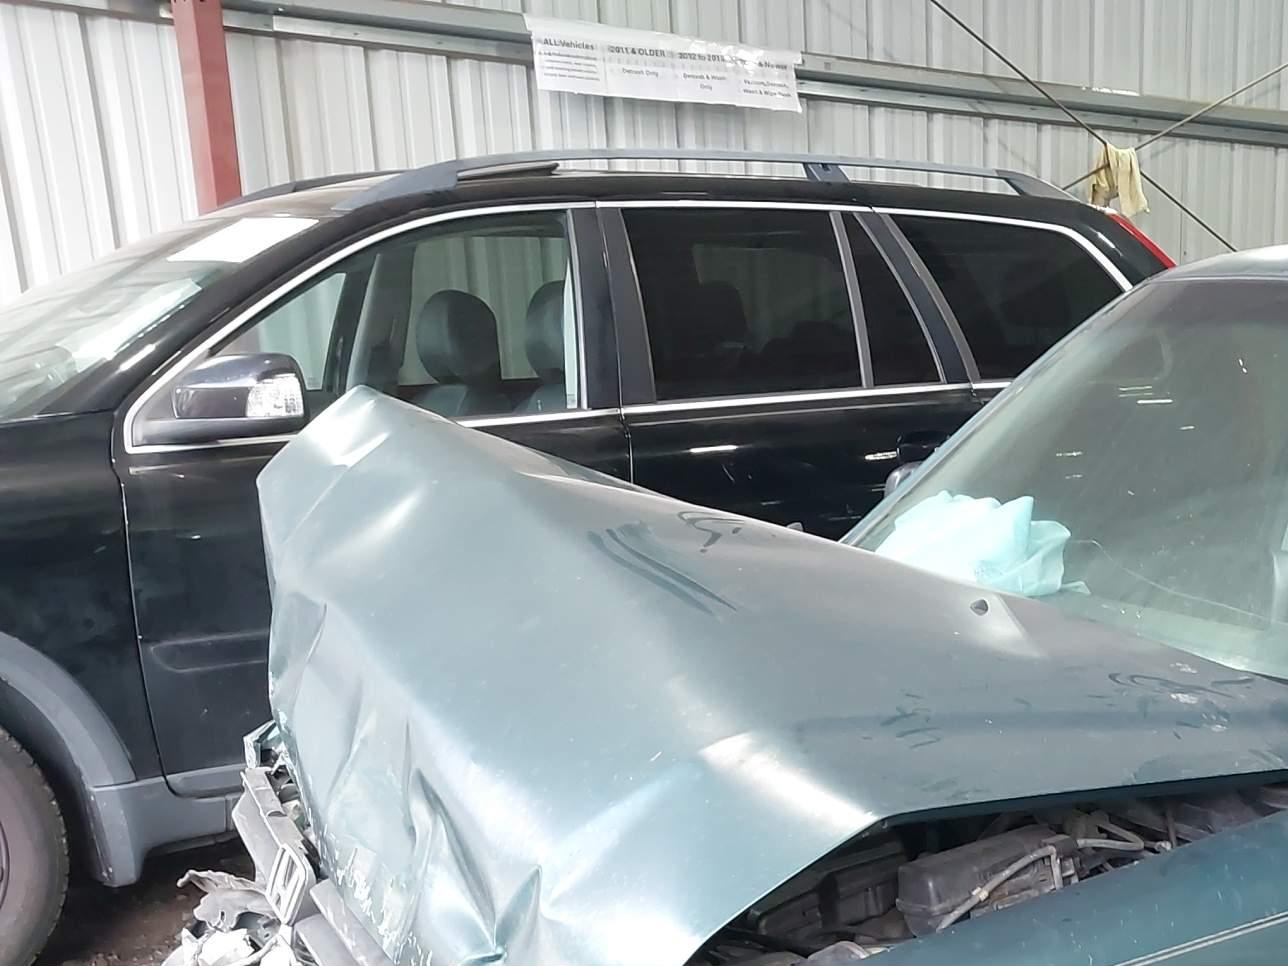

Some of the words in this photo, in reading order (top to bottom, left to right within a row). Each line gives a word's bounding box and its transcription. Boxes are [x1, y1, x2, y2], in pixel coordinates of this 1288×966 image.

[543, 38, 559, 46] ALL
[559, 39, 595, 50] Vehicles
[638, 48, 666, 58] OLDER
